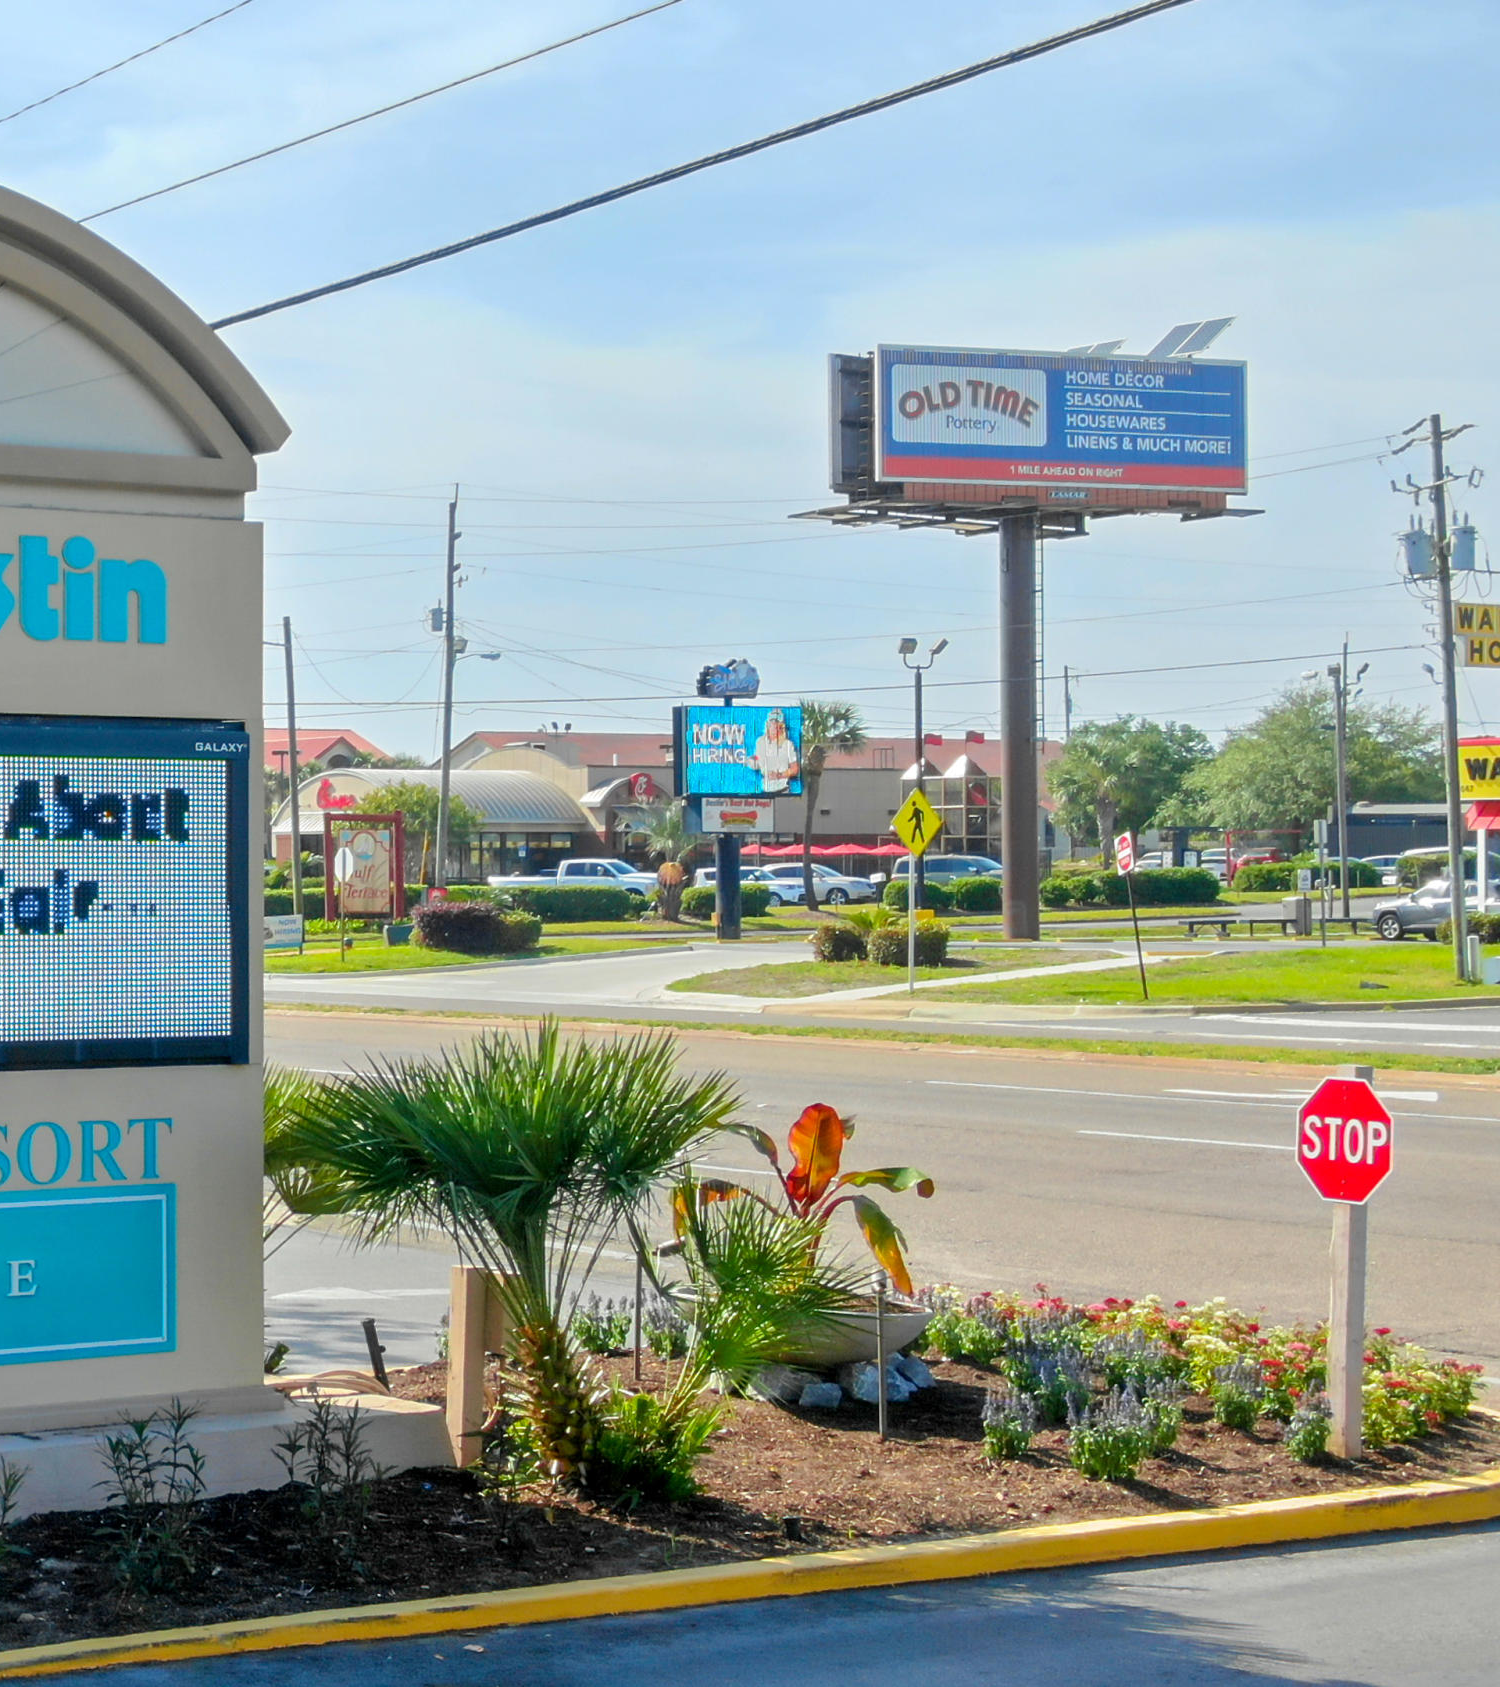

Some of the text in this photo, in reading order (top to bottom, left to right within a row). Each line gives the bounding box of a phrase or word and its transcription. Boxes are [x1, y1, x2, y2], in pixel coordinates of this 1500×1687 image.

[1066, 371, 1110, 386] HOME
[898, 379, 1040, 428] OLD TIME
[1065, 392, 1143, 408] SEASONAL
[946, 415, 997, 433] Pottery
[1065, 413, 1166, 430] HOUSEWARES
[1066, 434, 1231, 454] LINENS & MUCH MORE!
[1018, 466, 1040, 475] MILE
[1043, 467, 1076, 476] AHEAD
[1078, 468, 1094, 477] ON
[1096, 468, 1124, 477] RIGHT
[693, 723, 746, 745] NOW
[195, 742, 244, 752] GALAXY
[693, 748, 746, 764] HIRING
[1302, 1115, 1388, 1165] STOP
[7, 1259, 38, 1298] E
